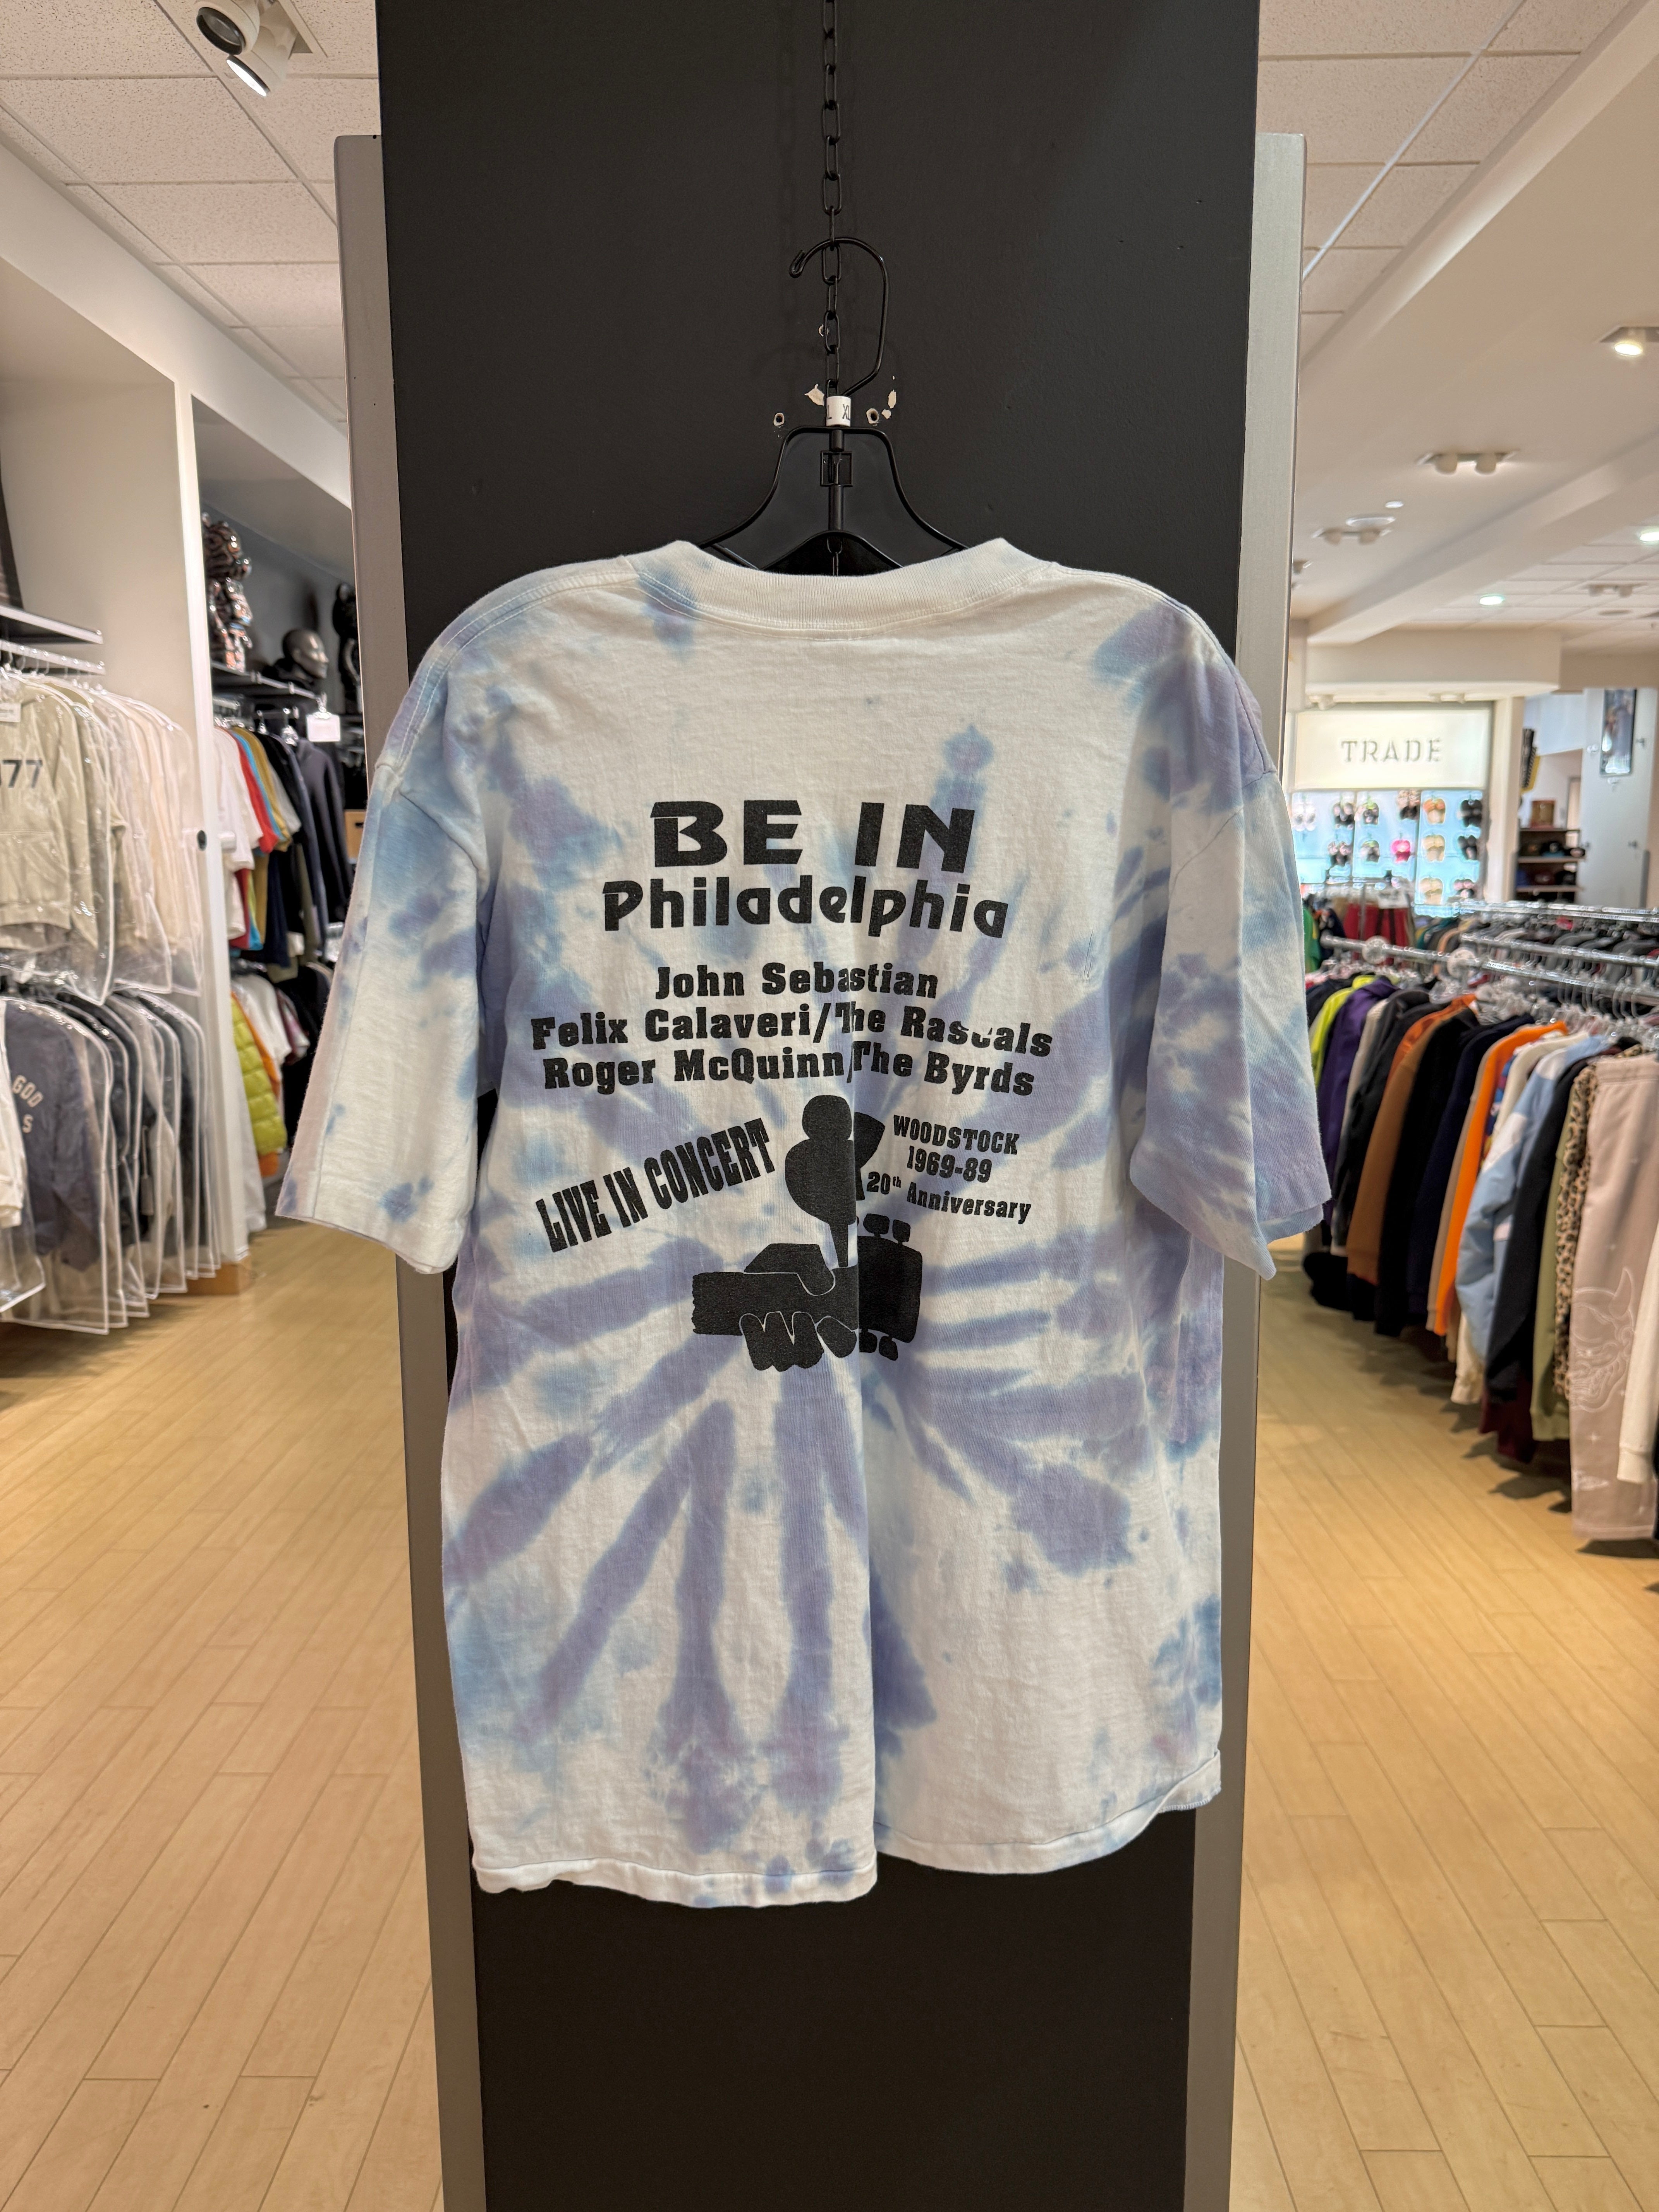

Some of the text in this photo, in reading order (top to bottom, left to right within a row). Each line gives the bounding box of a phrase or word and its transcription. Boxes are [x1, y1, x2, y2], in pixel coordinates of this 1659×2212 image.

[1341, 738, 1441, 762] TRADE
[650, 800, 975, 873] BE IN
[602, 875, 1009, 938] Philadelphia
[655, 961, 938, 1000] John Sebastian
[531, 1011, 629, 1050] Felix
[543, 1057, 656, 1095] Roger
[924, 1051, 1035, 1096] Byrds
[893, 1115, 1020, 1155] WOODSTOCK
[535, 1117, 775, 1253] LIVE IN CONCERT
[907, 1145, 993, 1183] 1969-89
[866, 1171, 1032, 1224] 20th Anniversary
